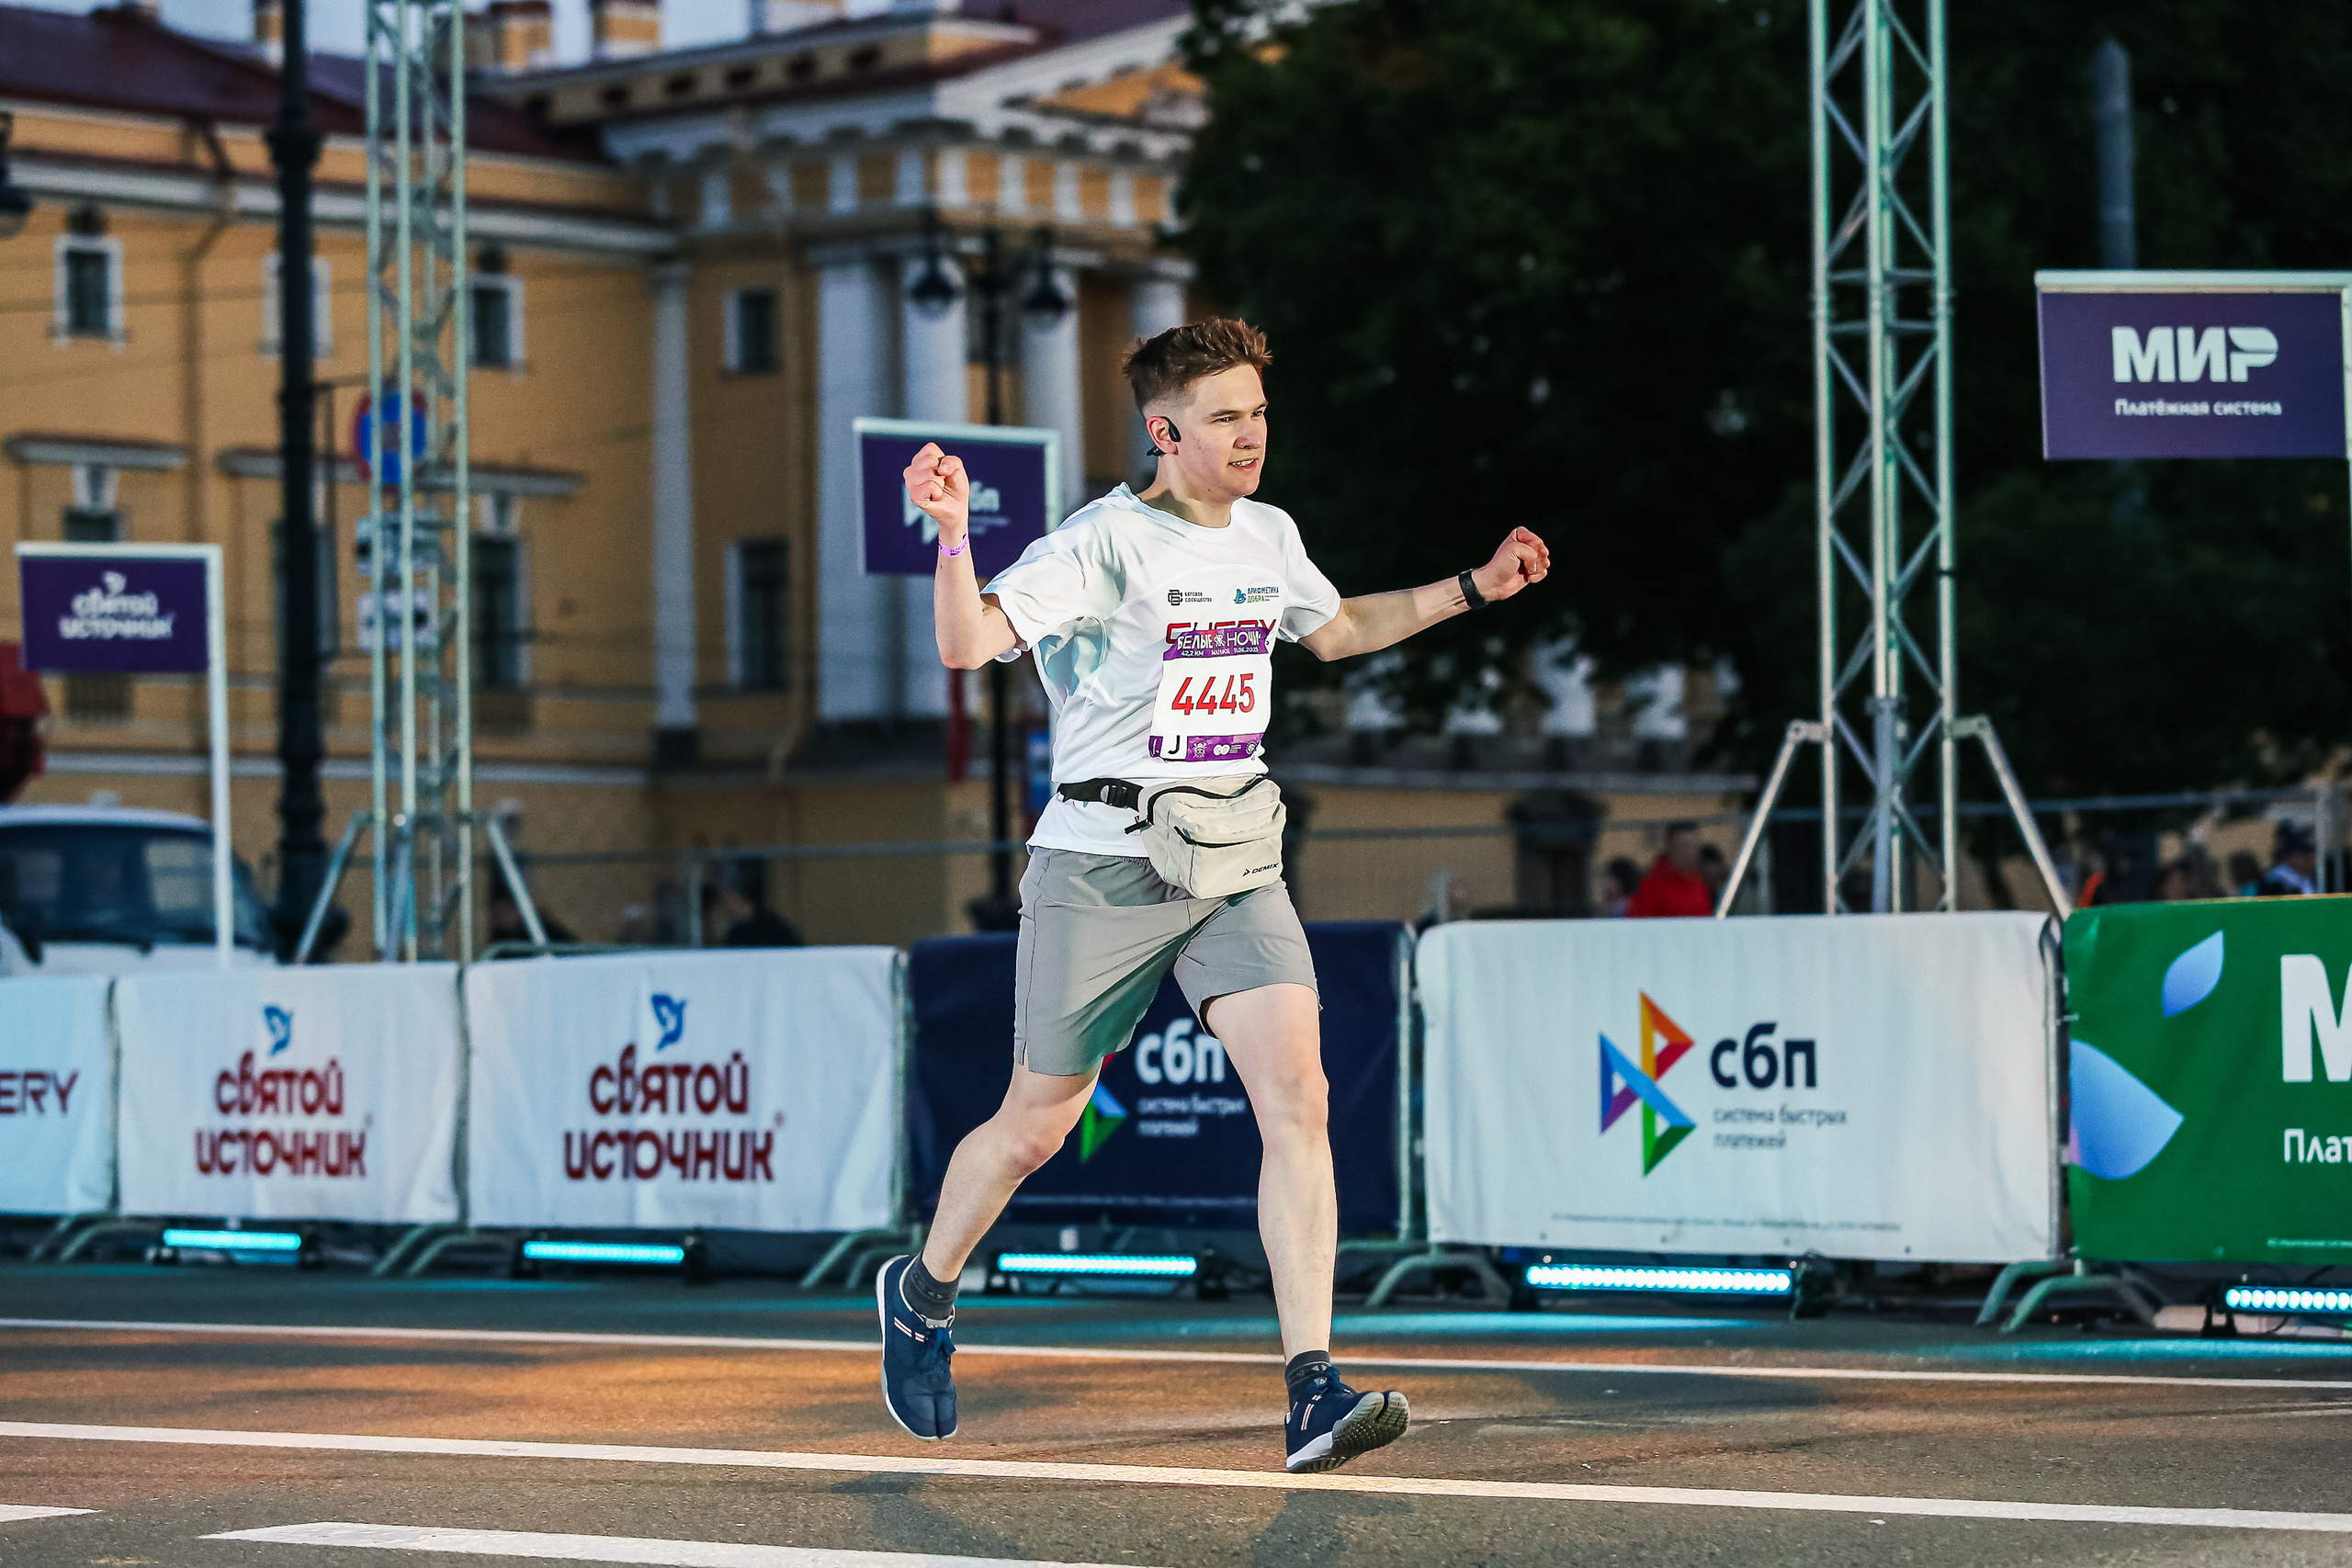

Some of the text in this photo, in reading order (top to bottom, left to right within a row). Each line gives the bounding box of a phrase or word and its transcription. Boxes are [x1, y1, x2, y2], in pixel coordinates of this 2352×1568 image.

[2112, 326, 2278, 383] МИР
[2115, 398, 2282, 416] Платёжная система
[1247, 586, 1280, 595] АРИФМЕТИКА
[1247, 594, 1265, 604] ДОБРА
[1176, 632, 1213, 650] БЕЛЫЕ
[1171, 673, 1256, 715] 4445
[1251, 863, 1279, 874] DEMIX
[1136, 1017, 1226, 1085] сбп
[1711, 1021, 1817, 1089] сбп
